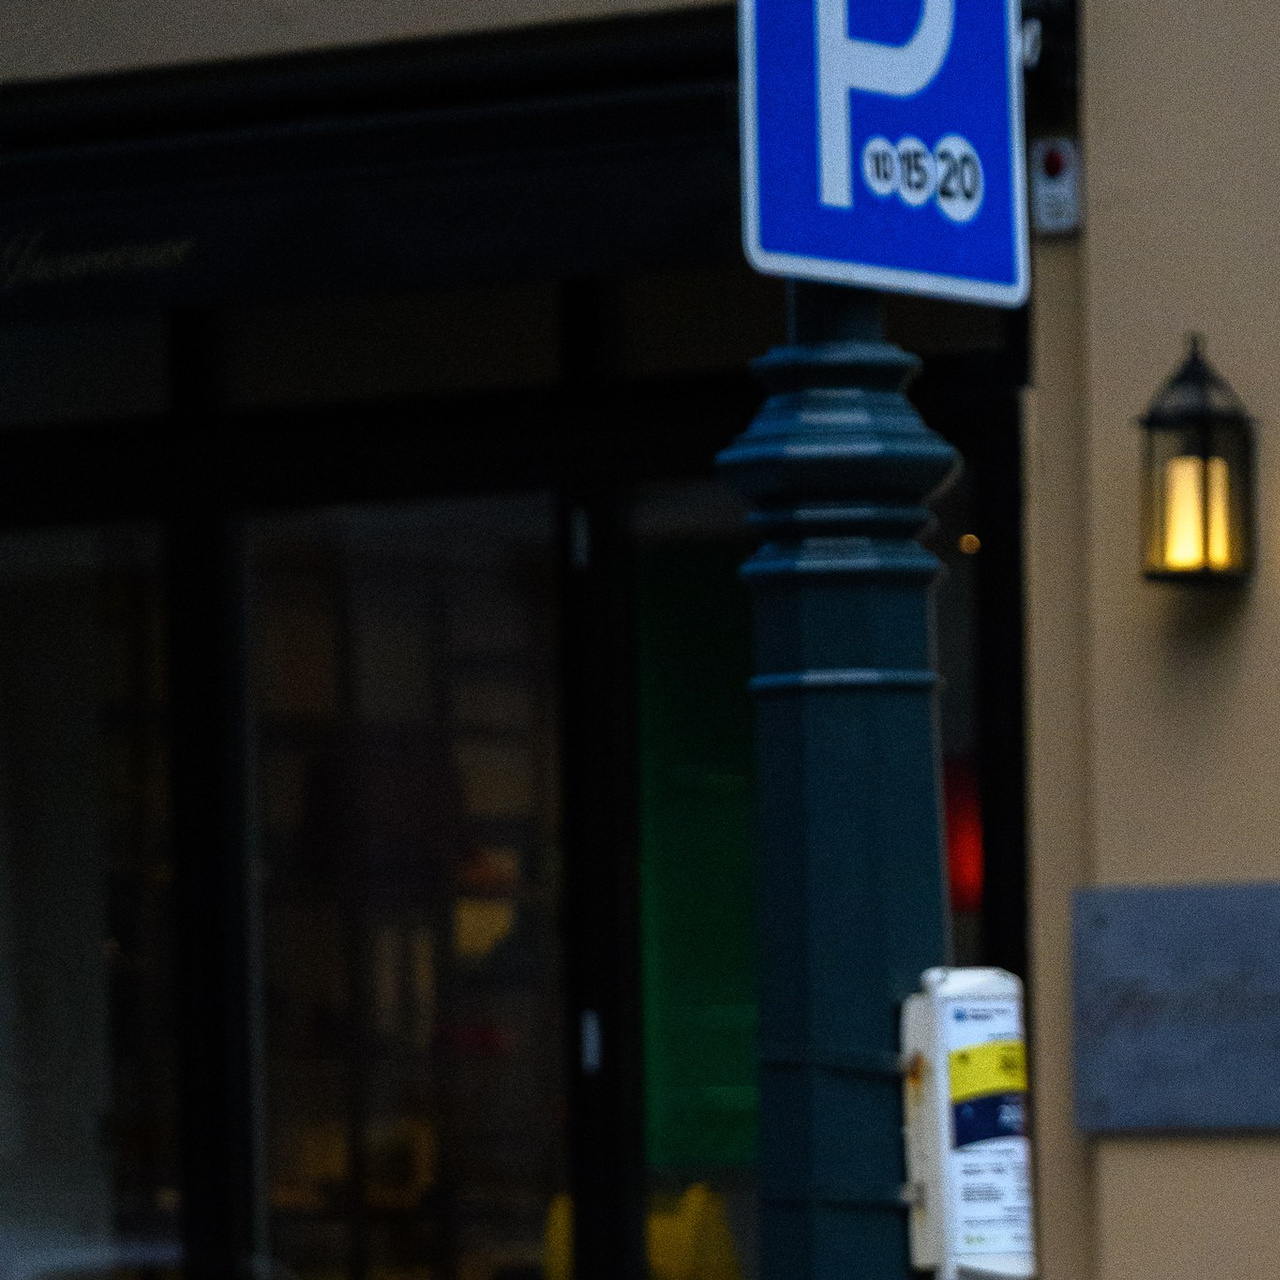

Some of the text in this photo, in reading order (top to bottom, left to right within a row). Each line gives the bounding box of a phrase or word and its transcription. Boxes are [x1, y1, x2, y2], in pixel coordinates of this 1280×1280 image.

[813, 0, 955, 208] P
[901, 150, 928, 191] 15
[937, 150, 981, 201] 20
